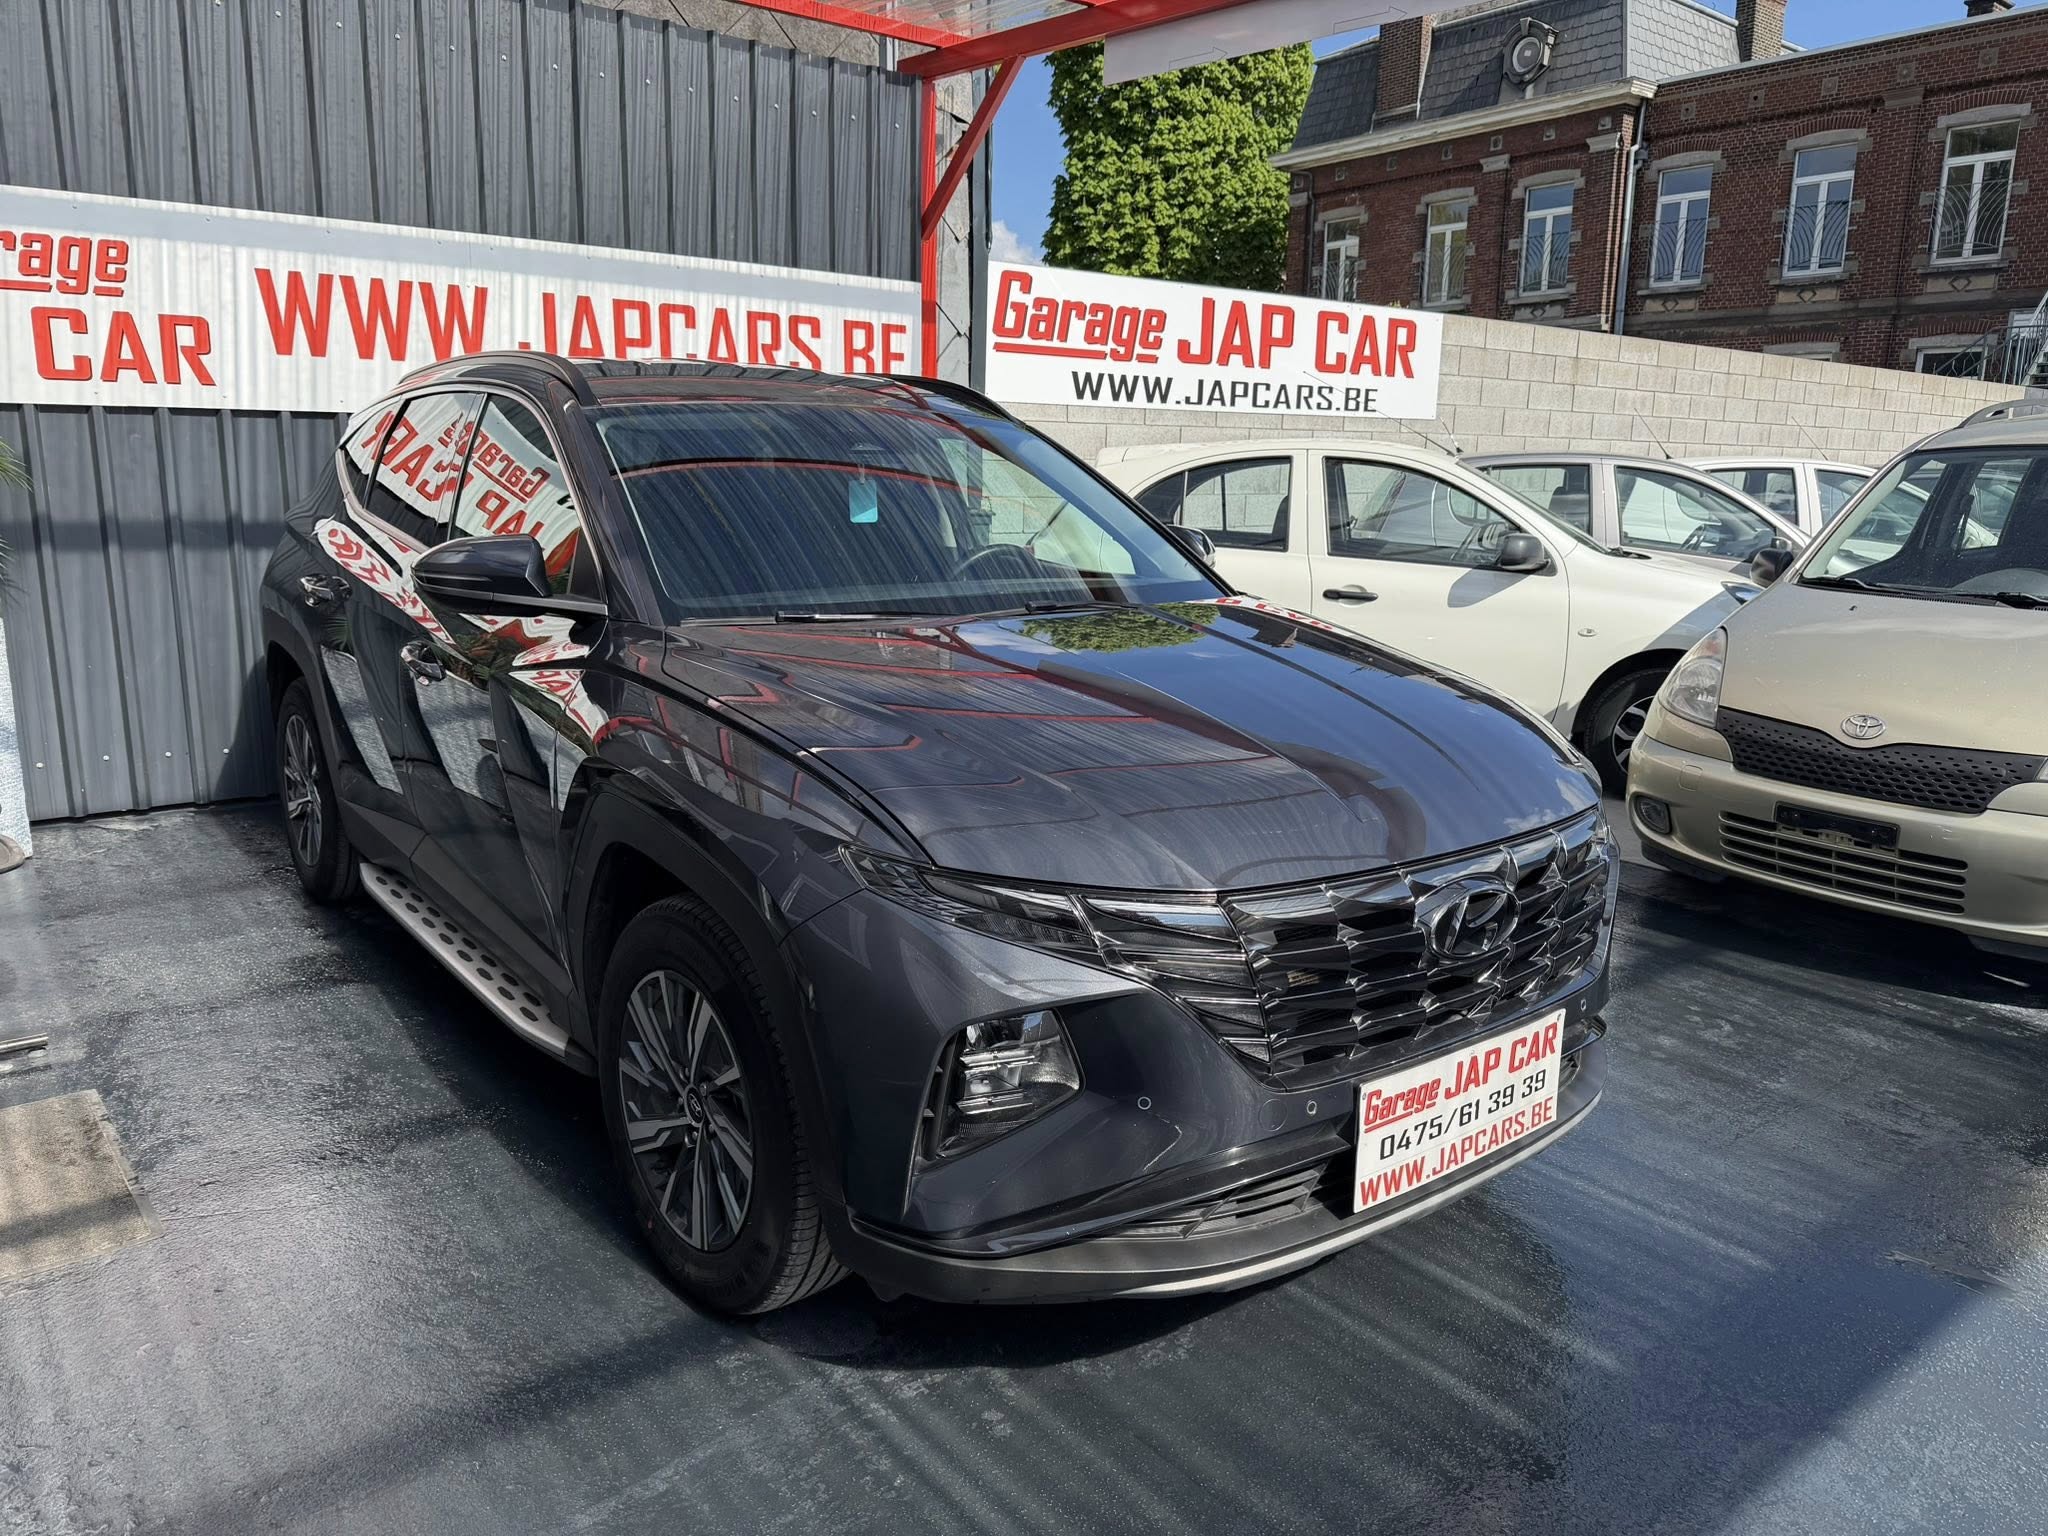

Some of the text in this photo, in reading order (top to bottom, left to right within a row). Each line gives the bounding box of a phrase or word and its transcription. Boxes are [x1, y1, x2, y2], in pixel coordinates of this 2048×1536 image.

[30, 306, 217, 386] CAR
[992, 270, 1417, 378] Garage JAP CAR
[1071, 370, 1378, 412] WWW.JAPCARS.BE
[1364, 1022, 1558, 1128] Garage JAP CAR
[1380, 1068, 1546, 1160] 0475/61 39 39
[1360, 1096, 1554, 1206] WWW.JAPCARS.BE
